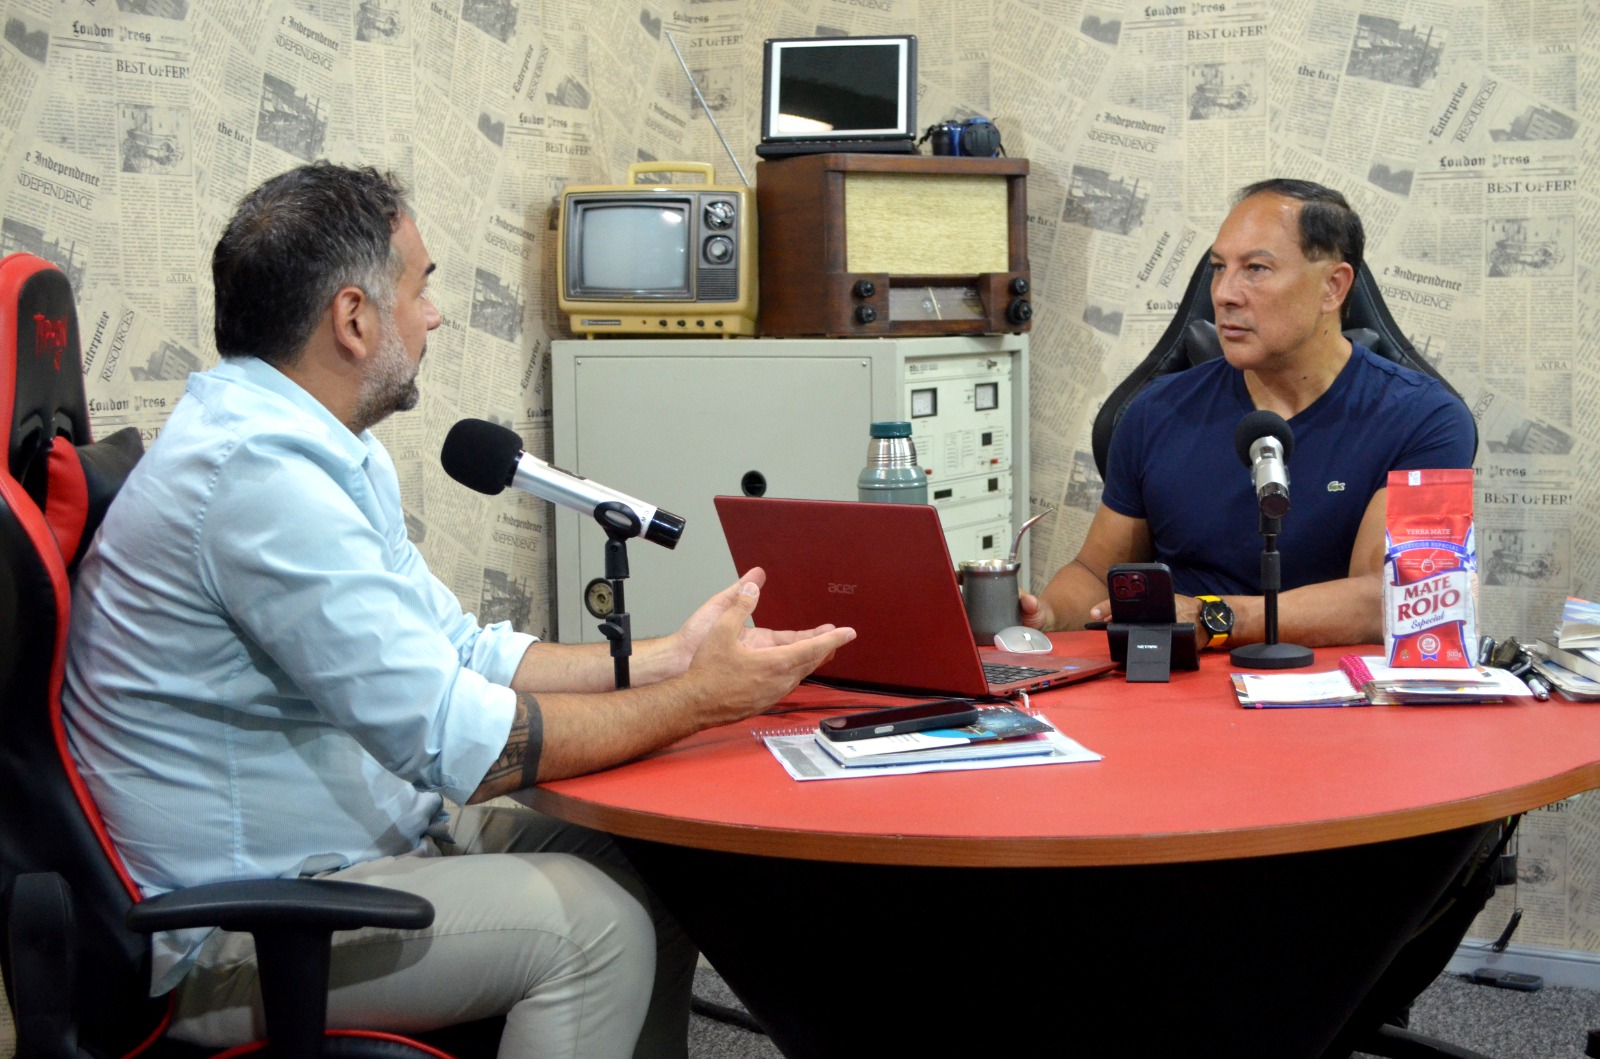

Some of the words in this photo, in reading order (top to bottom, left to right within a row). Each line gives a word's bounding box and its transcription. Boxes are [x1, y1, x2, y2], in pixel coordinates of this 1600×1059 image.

[1144, 6, 1186, 19] London
[72, 20, 114, 38] London
[1187, 28, 1219, 41] BEST
[116, 59, 145, 75] BEST
[148, 63, 190, 79] OFFER!
[1298, 65, 1315, 78] the
[1455, 79, 1498, 143] RESOURCES
[217, 122, 233, 137] the
[1103, 111, 1166, 134] Independence
[545, 142, 564, 154] BEST
[34, 150, 101, 187] Independence
[1439, 156, 1486, 170] London
[1487, 182, 1522, 194] BEST
[1525, 180, 1577, 193] OFFER!
[1160, 229, 1197, 288] RESOURCES
[1393, 265, 1462, 292] Independence
[1146, 300, 1180, 313] Londo
[102, 308, 135, 383] RESOURCES
[89, 398, 129, 415] London
[141, 428, 161, 441] EST
[1484, 492, 1519, 505] BEST
[1522, 494, 1573, 506] OFFER!
[1406, 528, 1430, 536] YERBA
[828, 582, 857, 595] acer
[1404, 576, 1451, 601] MATE
[1397, 589, 1461, 622] ROJO
[1411, 611, 1445, 630] Especial
